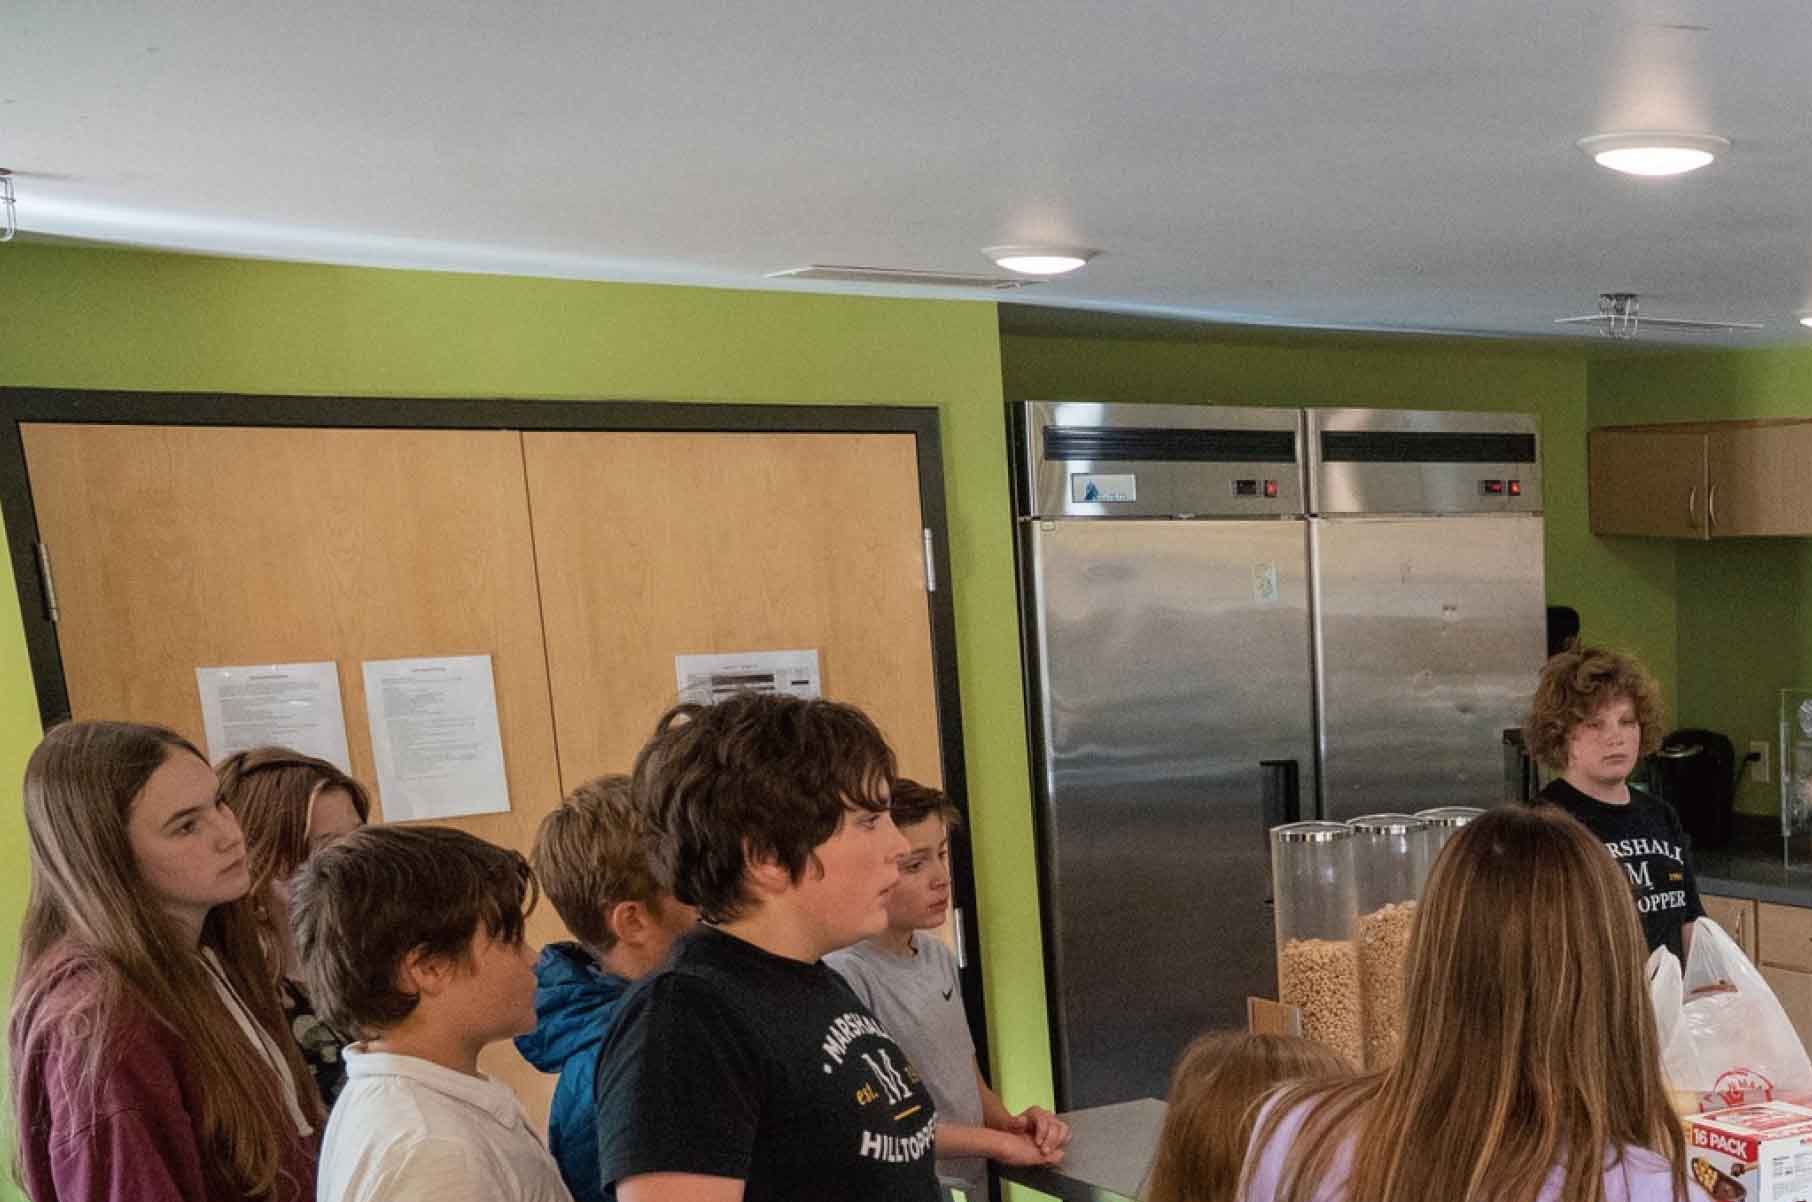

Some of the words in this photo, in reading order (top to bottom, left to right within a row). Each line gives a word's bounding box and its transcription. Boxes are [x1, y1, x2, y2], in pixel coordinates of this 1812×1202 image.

[1605, 838, 1684, 864] RSHALL
[1637, 890, 1686, 913] OPPER
[1694, 1127, 1707, 1145] 16
[1709, 1132, 1748, 1160] PACK
